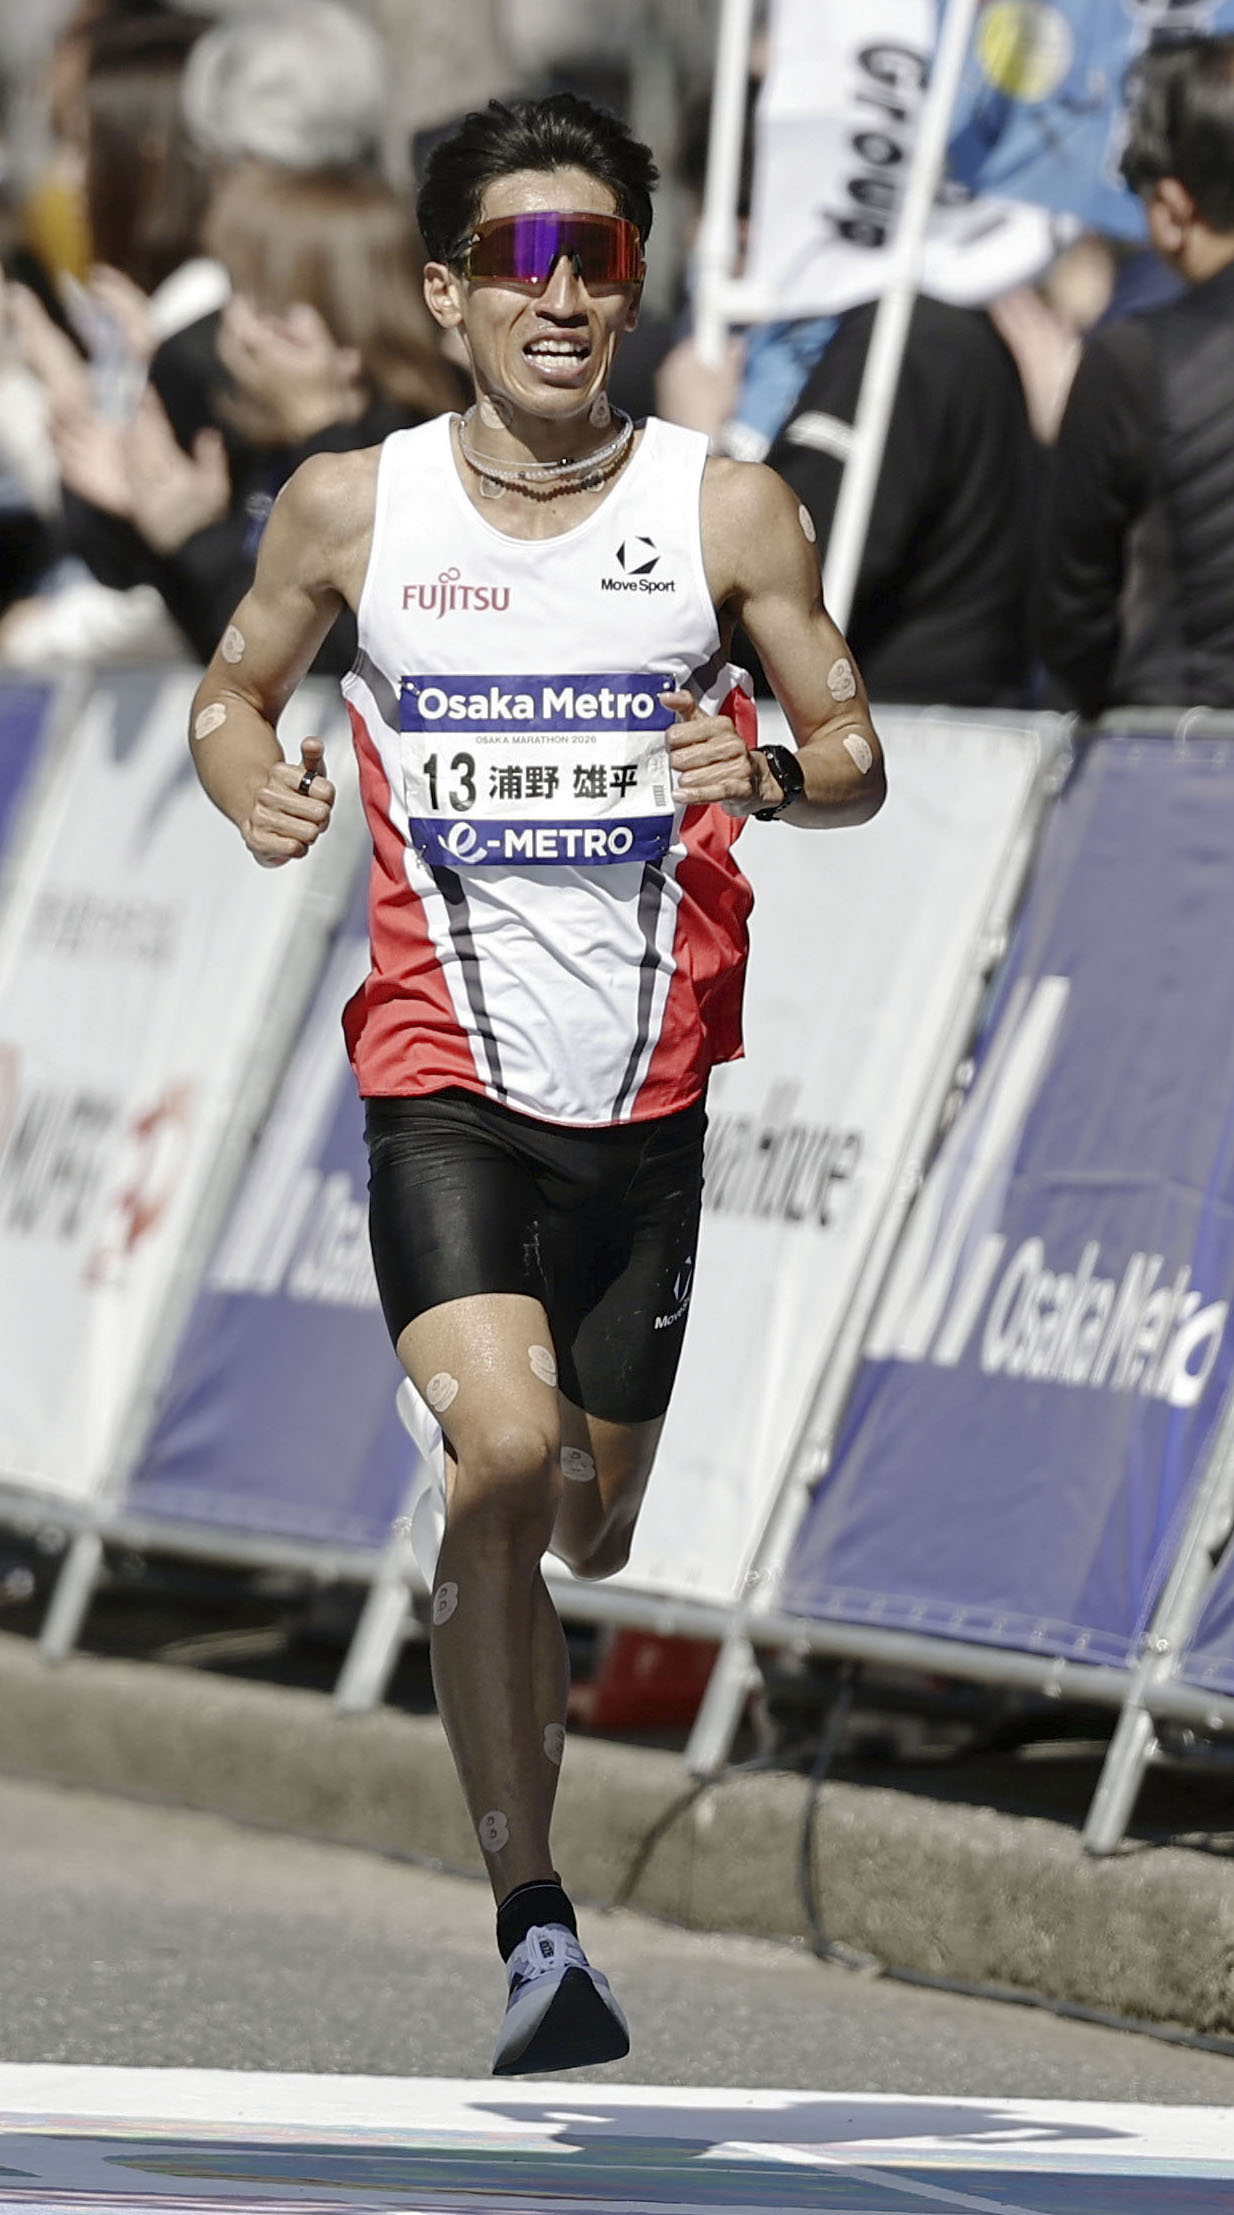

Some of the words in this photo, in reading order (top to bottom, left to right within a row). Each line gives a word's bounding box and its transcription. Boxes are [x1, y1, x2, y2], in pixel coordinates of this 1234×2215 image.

[401, 567, 511, 620] FUJITSU
[417, 687, 534, 720] Osaka
[542, 687, 655, 719] Metro
[475, 735, 509, 745] OSAKA
[512, 735, 568, 745] MARATHON
[423, 751, 477, 812] 13
[488, 764, 560, 800] 浦野
[573, 764, 639, 799] 雄平
[981, 1236, 1117, 1388] Osaka
[1090, 1251, 1229, 1408] Metro
